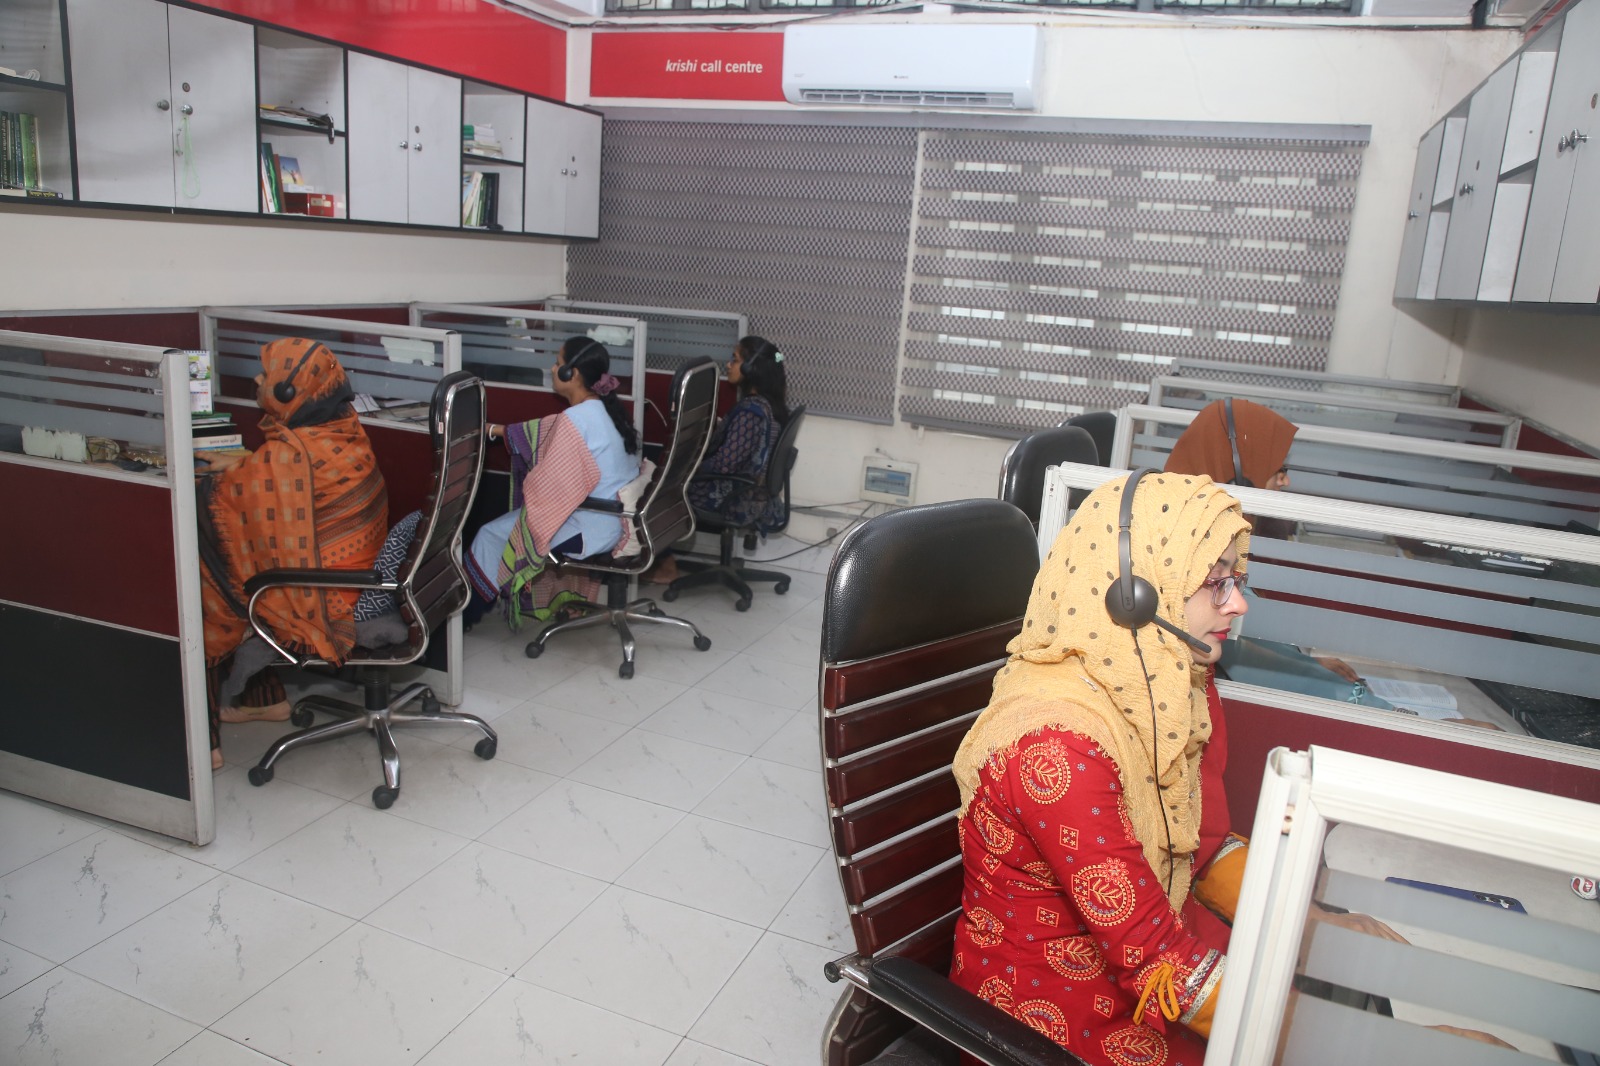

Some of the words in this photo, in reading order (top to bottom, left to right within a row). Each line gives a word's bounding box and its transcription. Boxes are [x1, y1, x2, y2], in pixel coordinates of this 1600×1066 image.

[666, 59, 698, 72] krishi
[701, 60, 721, 72] call
[725, 61, 763, 73] centre
